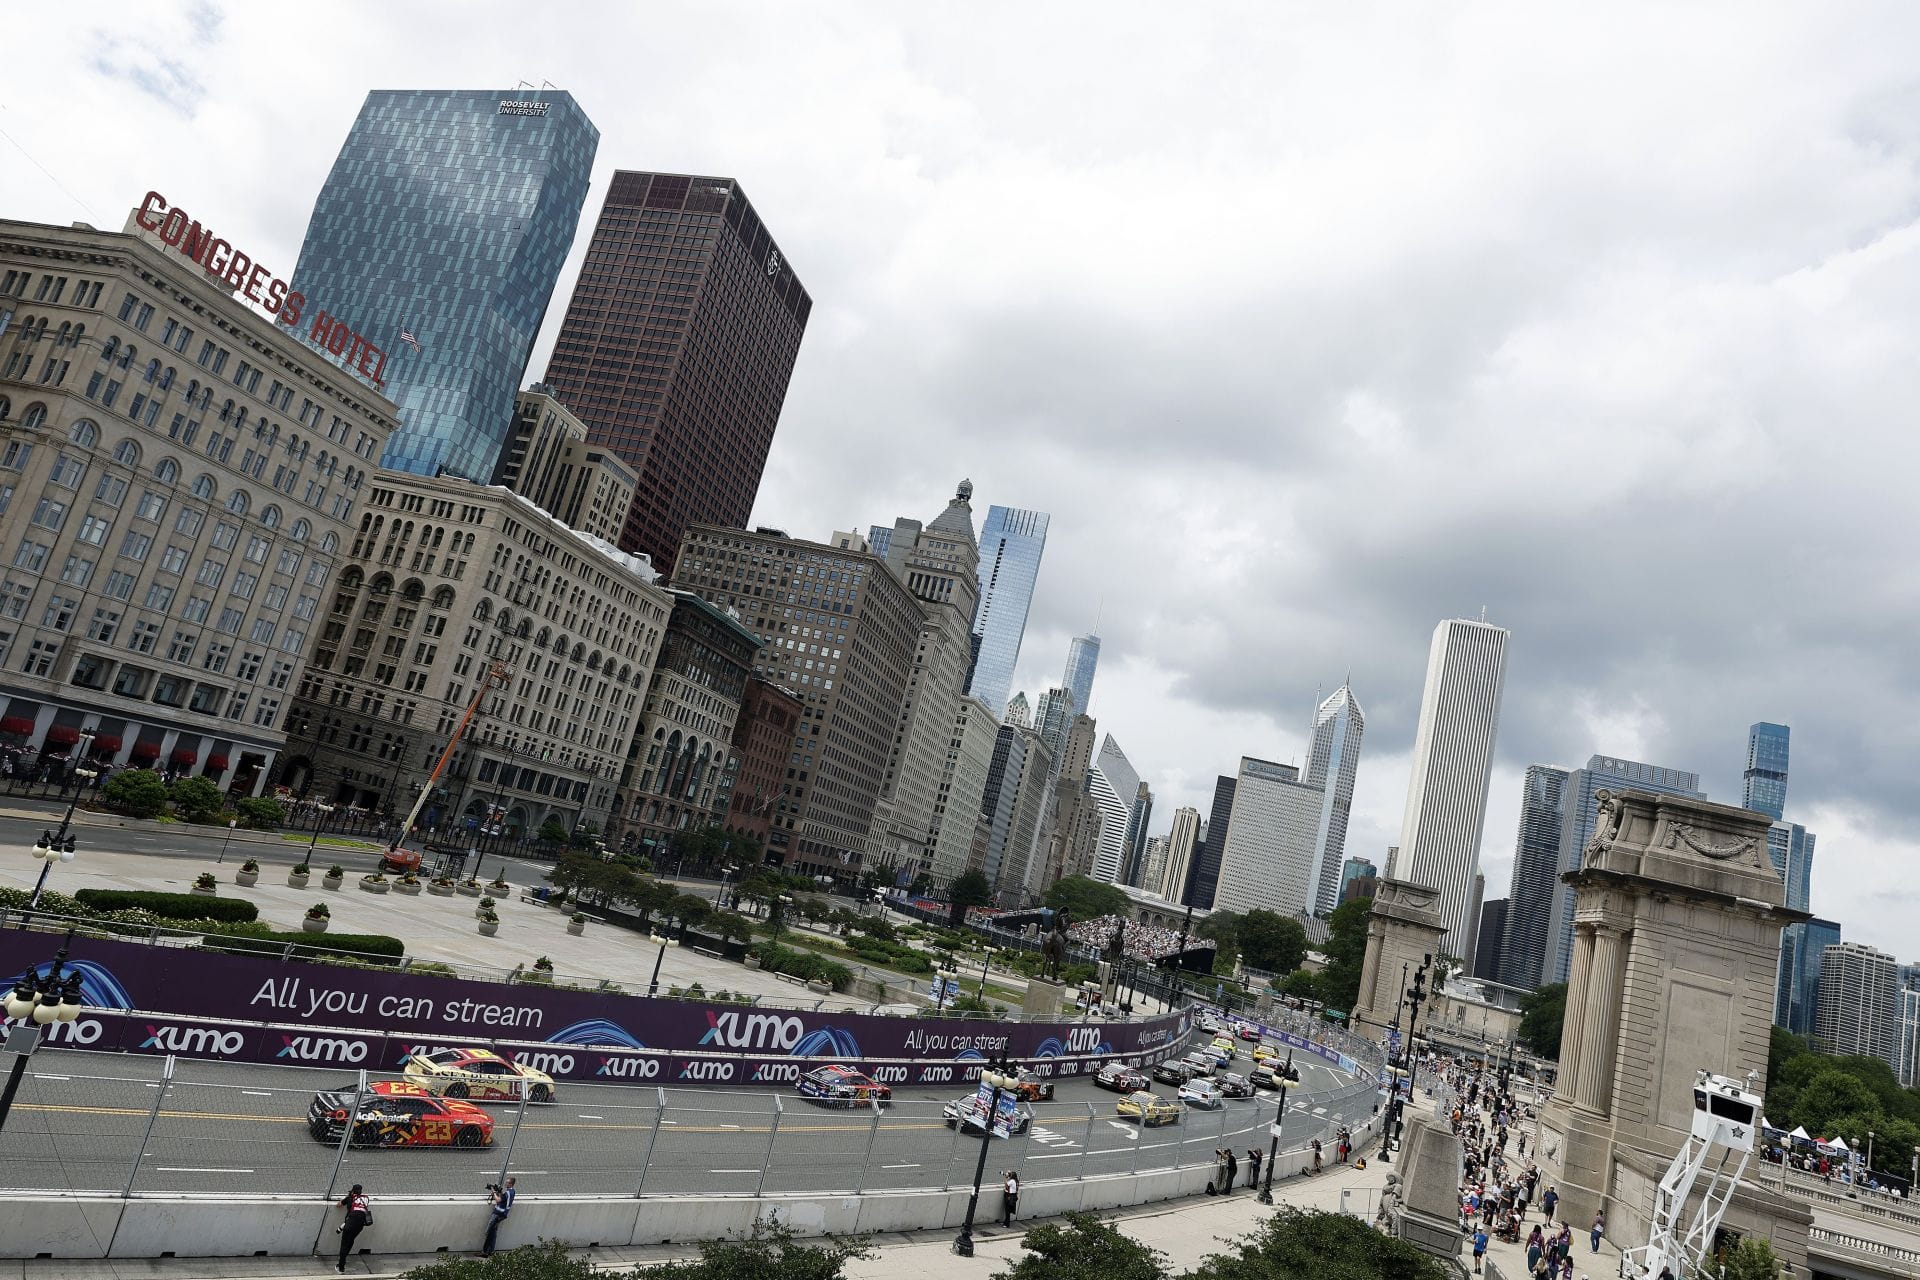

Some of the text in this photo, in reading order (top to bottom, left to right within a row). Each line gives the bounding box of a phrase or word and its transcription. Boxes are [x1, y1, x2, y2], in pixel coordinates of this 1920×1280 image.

[498, 107, 549, 116] UNIVERSITY
[500, 101, 550, 109] ROOSEVELT
[136, 191, 388, 387] CONGRESS HOTEL
[251, 977, 543, 1028] All you can stream
[139, 1025, 244, 1054] xumo
[698, 1011, 803, 1050] xumo
[904, 1029, 923, 1049] All
[923, 1034, 948, 1054] you
[951, 1035, 972, 1050] can
[276, 1034, 368, 1063] xumo
[596, 1056, 659, 1078] xumo
[679, 1061, 734, 1080] xumo
[751, 1063, 800, 1081] xumo
[425, 1121, 451, 1140] 23
